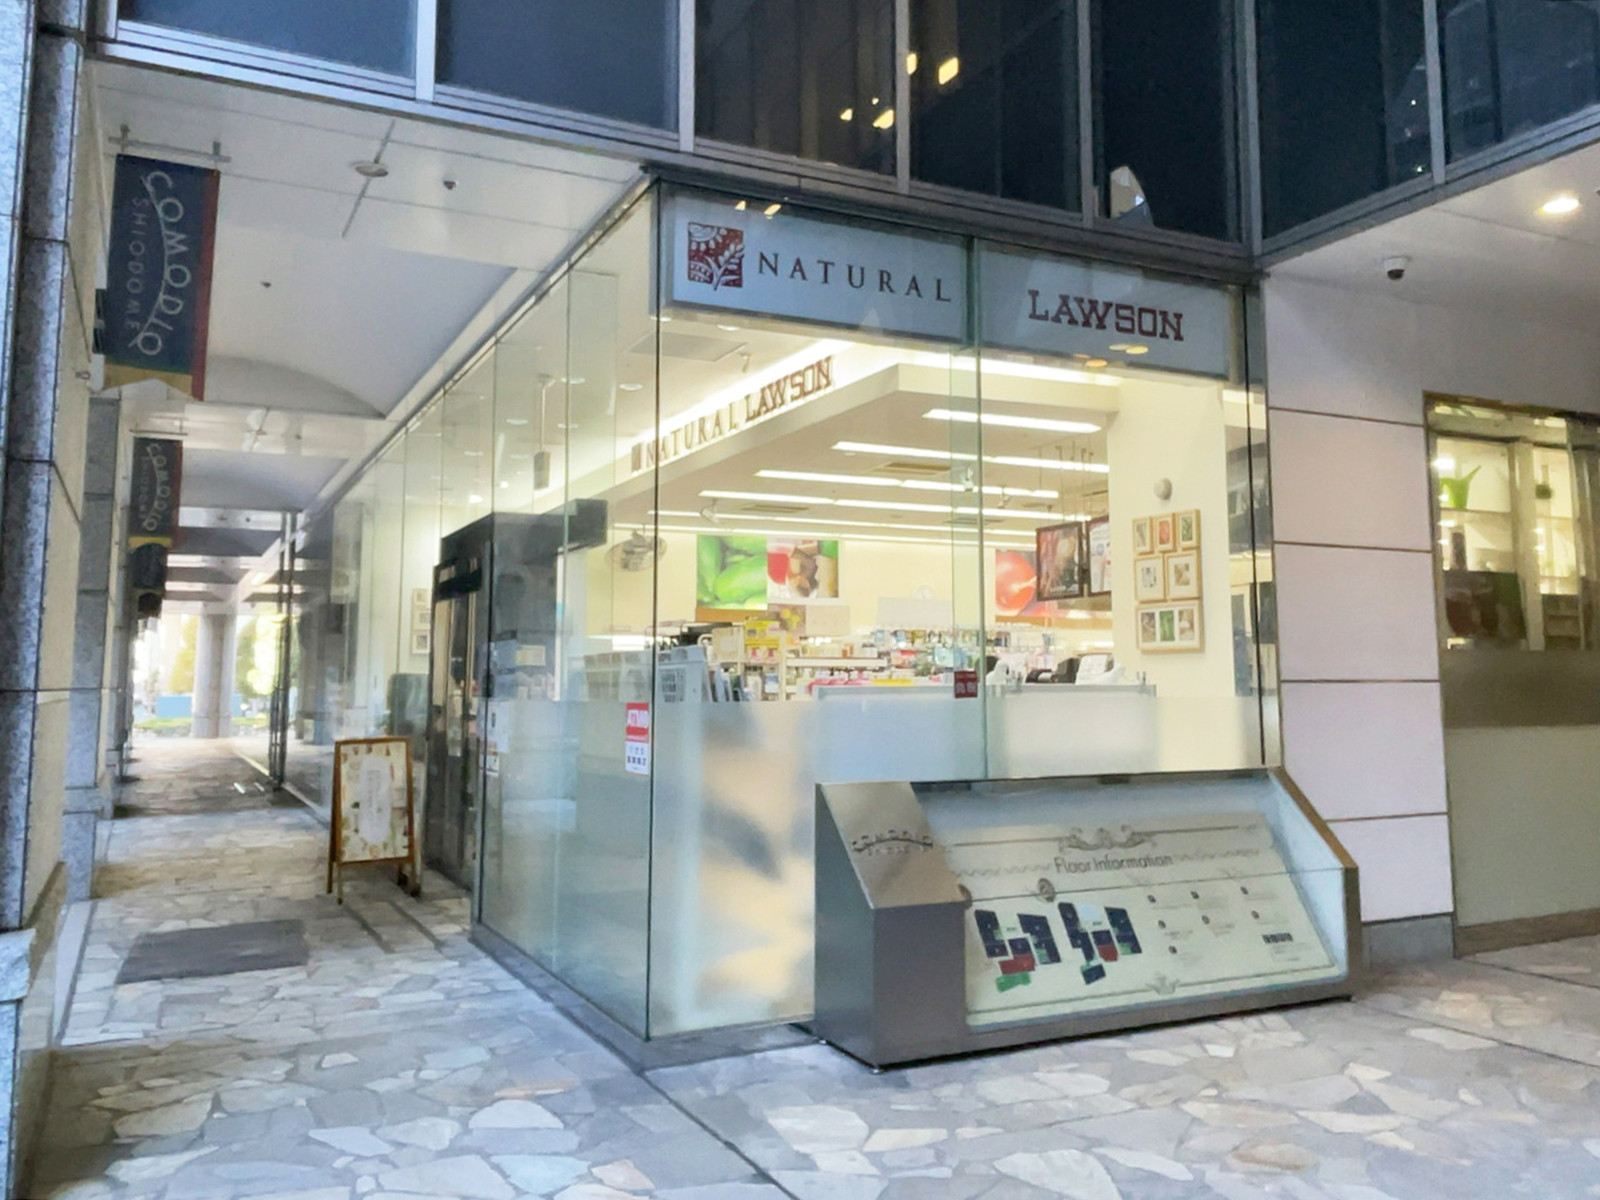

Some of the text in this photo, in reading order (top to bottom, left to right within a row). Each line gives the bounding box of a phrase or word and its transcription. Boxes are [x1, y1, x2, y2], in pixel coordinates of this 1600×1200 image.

[126, 198, 149, 330] SHIODOME
[138, 170, 191, 355] COMODIO
[758, 252, 1184, 341] NATURAL LAWSON
[646, 355, 832, 468] NATURAL LAWSON
[1054, 853, 1174, 874] Floor Information
